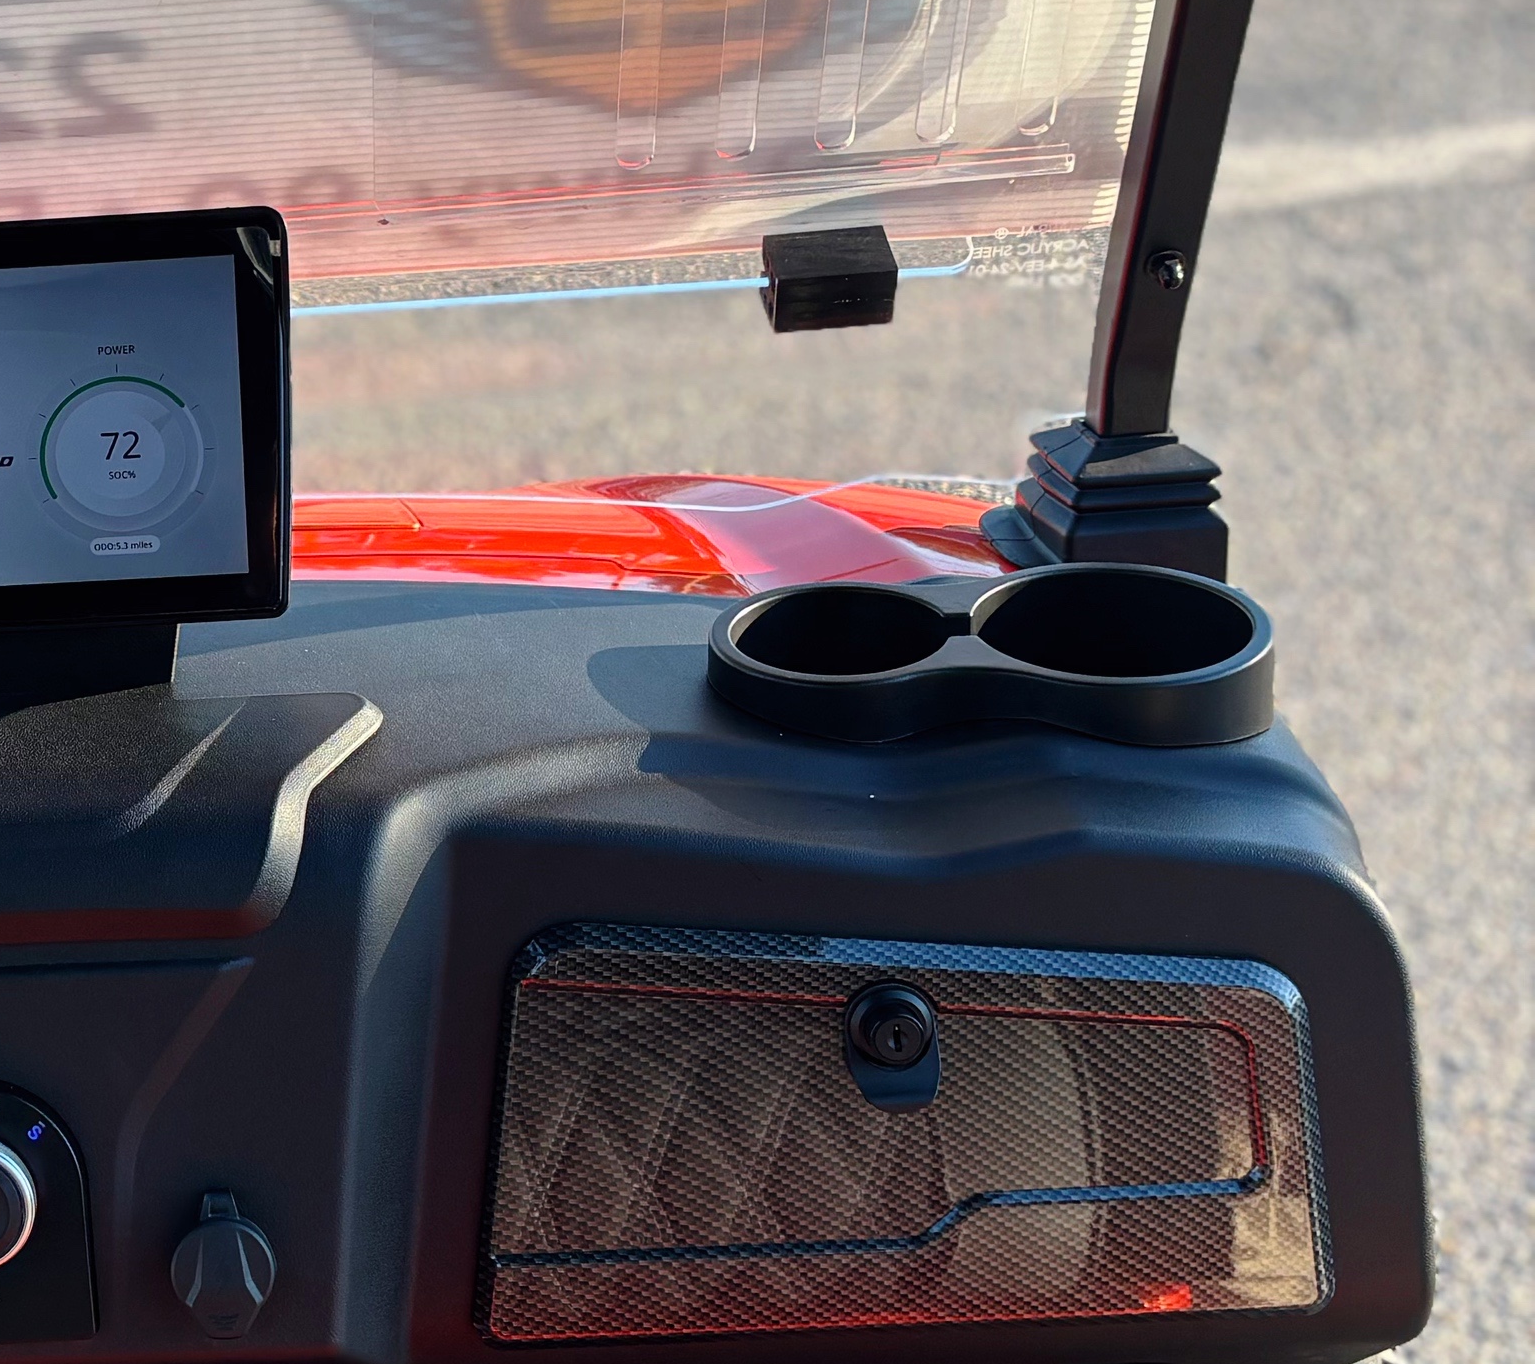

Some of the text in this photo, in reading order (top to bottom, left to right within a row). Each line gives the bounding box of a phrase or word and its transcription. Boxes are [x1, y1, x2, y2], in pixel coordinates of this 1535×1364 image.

[97, 344, 136, 356] POWER
[100, 430, 141, 461] 72
[108, 470, 137, 481] SOC%
[130, 539, 154, 551] miles
[27, 1124, 42, 1141] S
